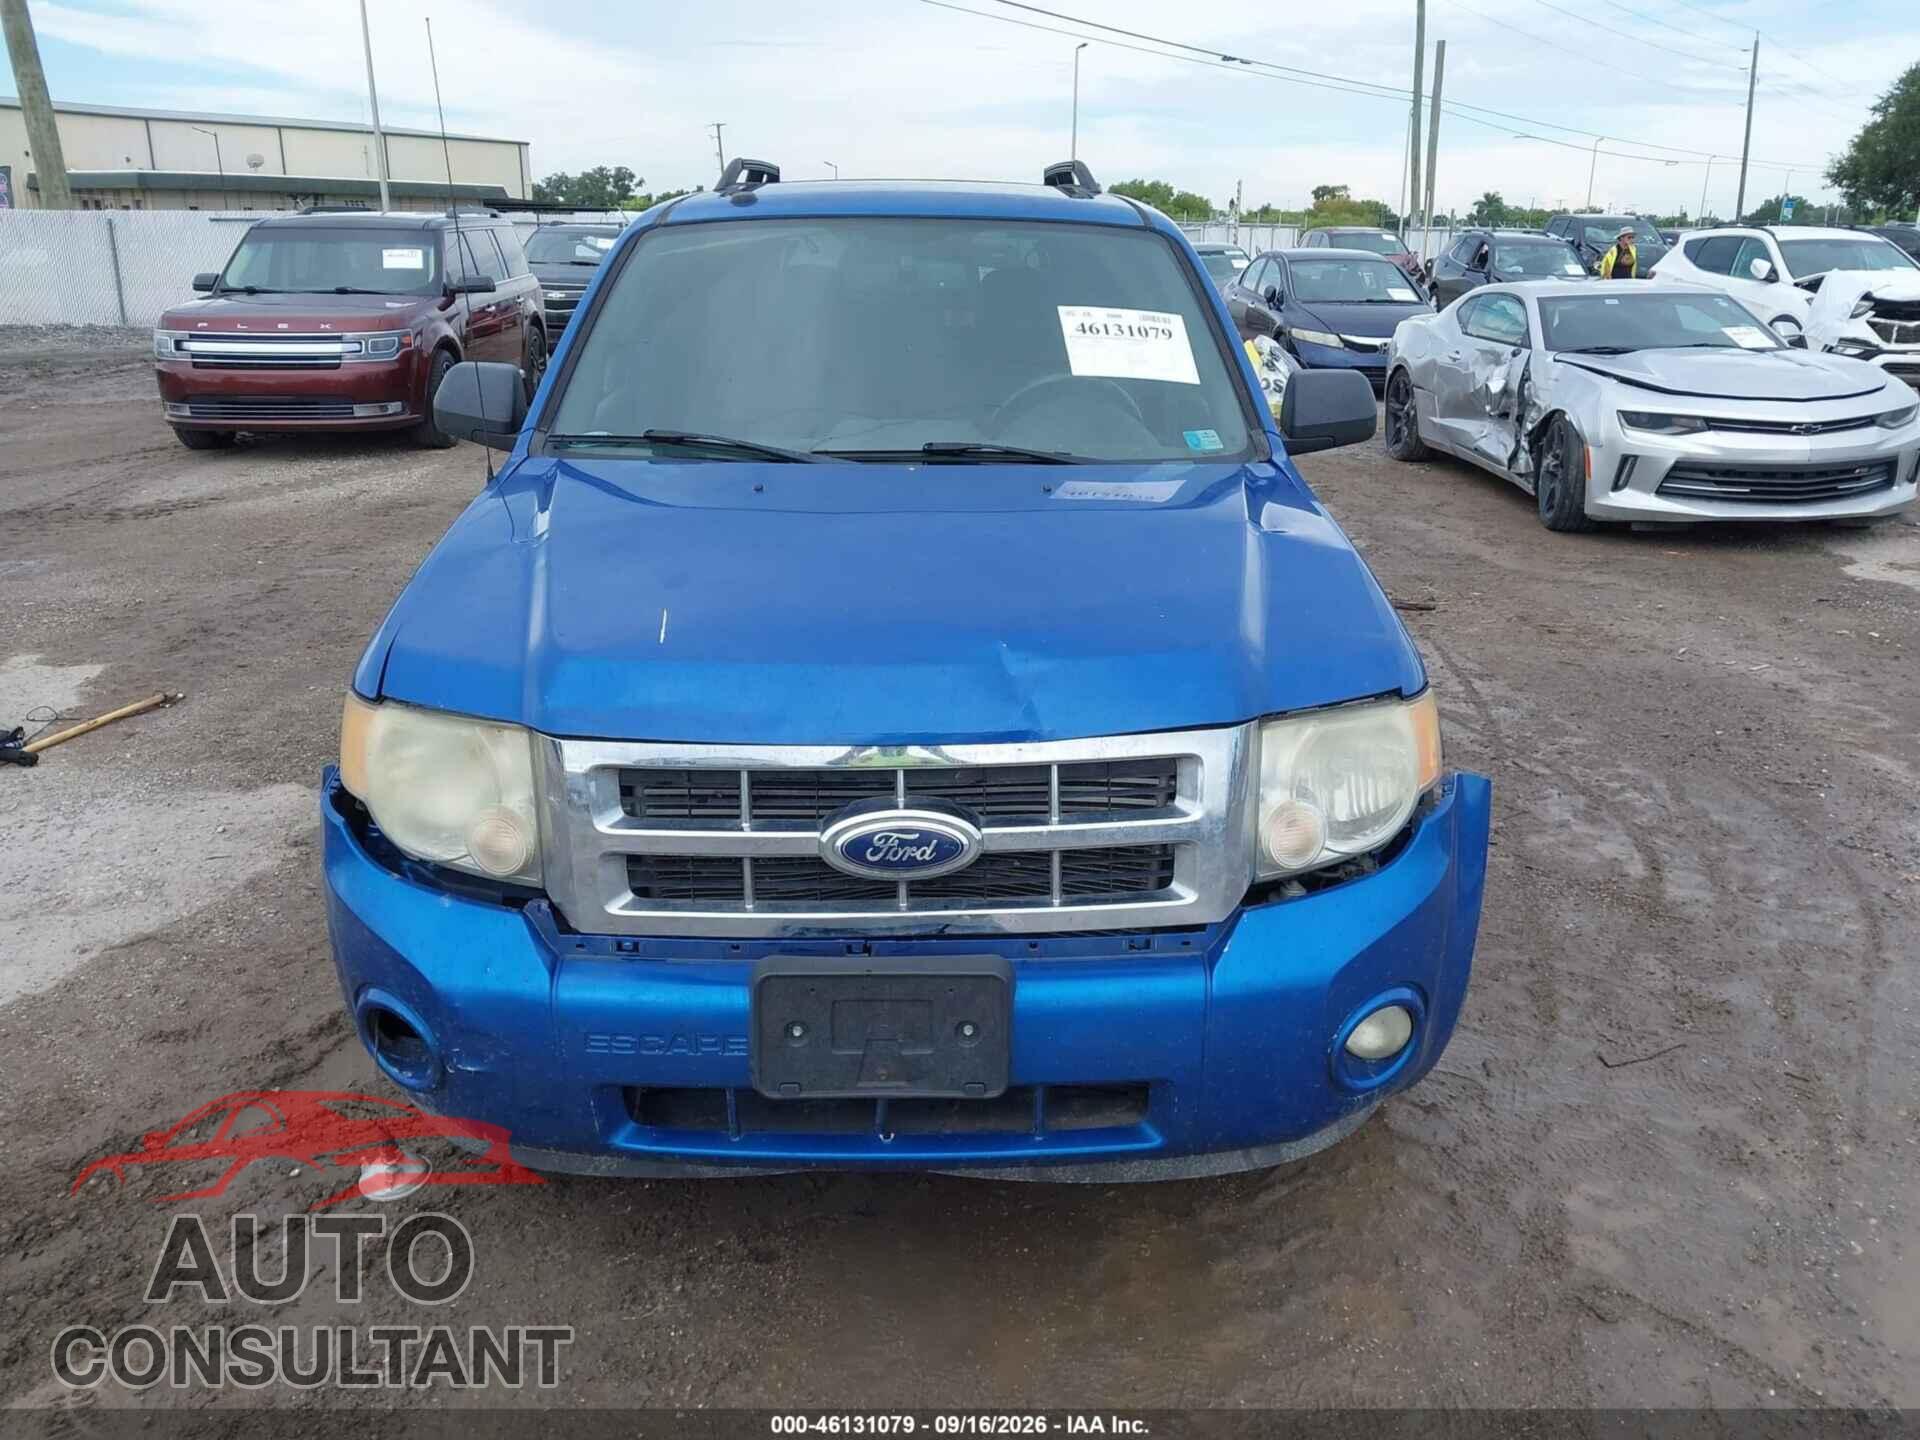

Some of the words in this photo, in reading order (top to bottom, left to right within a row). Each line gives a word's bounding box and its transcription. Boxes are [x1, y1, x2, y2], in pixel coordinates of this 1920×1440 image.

[1075, 321, 1173, 341] 46131079
[865, 832, 938, 862] Ford
[585, 1034, 748, 1056] ESCAPE
